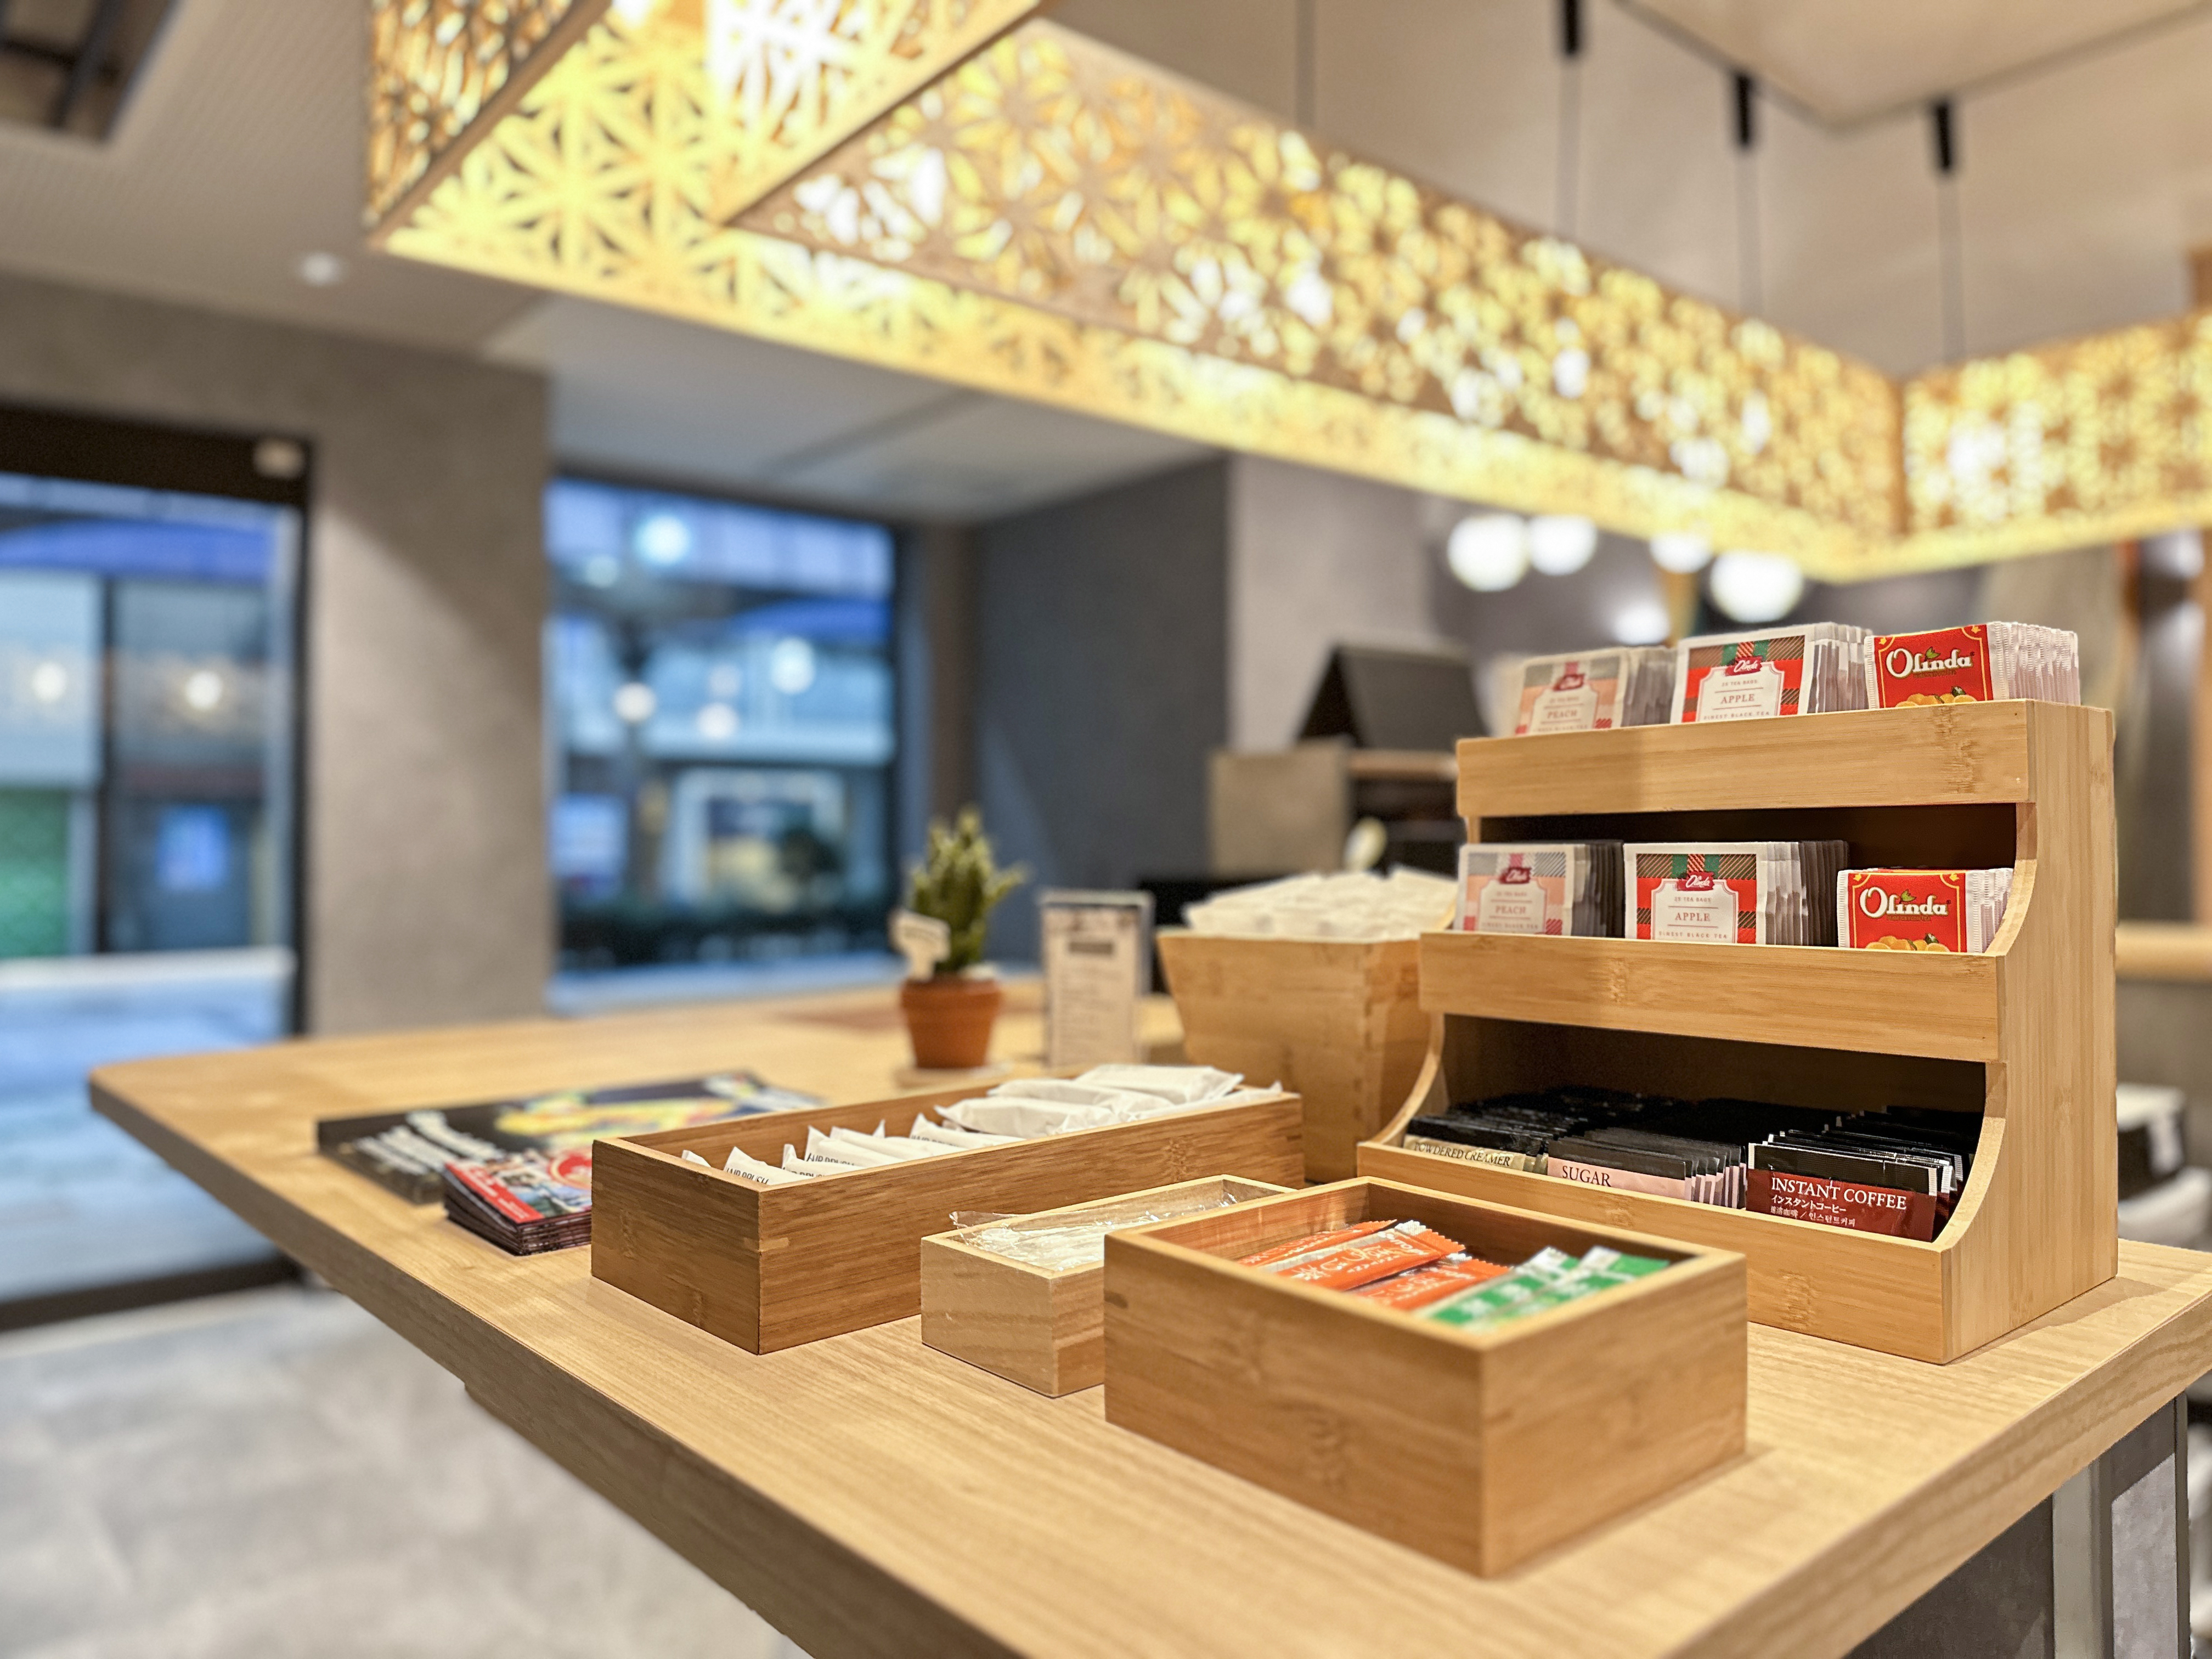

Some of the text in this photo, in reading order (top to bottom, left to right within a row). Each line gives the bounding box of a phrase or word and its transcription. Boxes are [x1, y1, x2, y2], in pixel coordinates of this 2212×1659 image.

[1886, 647, 1972, 678] Olinda
[1720, 693, 1755, 704] APPLE
[1495, 905, 1526, 915] PEACH
[1859, 886, 1949, 918] Olinda
[1674, 912, 1711, 922] APPLE
[1414, 1142, 1510, 1166] POWDERED CREAMER
[1562, 1165, 1611, 1187] SUGAR
[1771, 1177, 1907, 1210] INSTANT COFFEE
[1771, 1194, 1847, 1214] インスタントコーヒー
